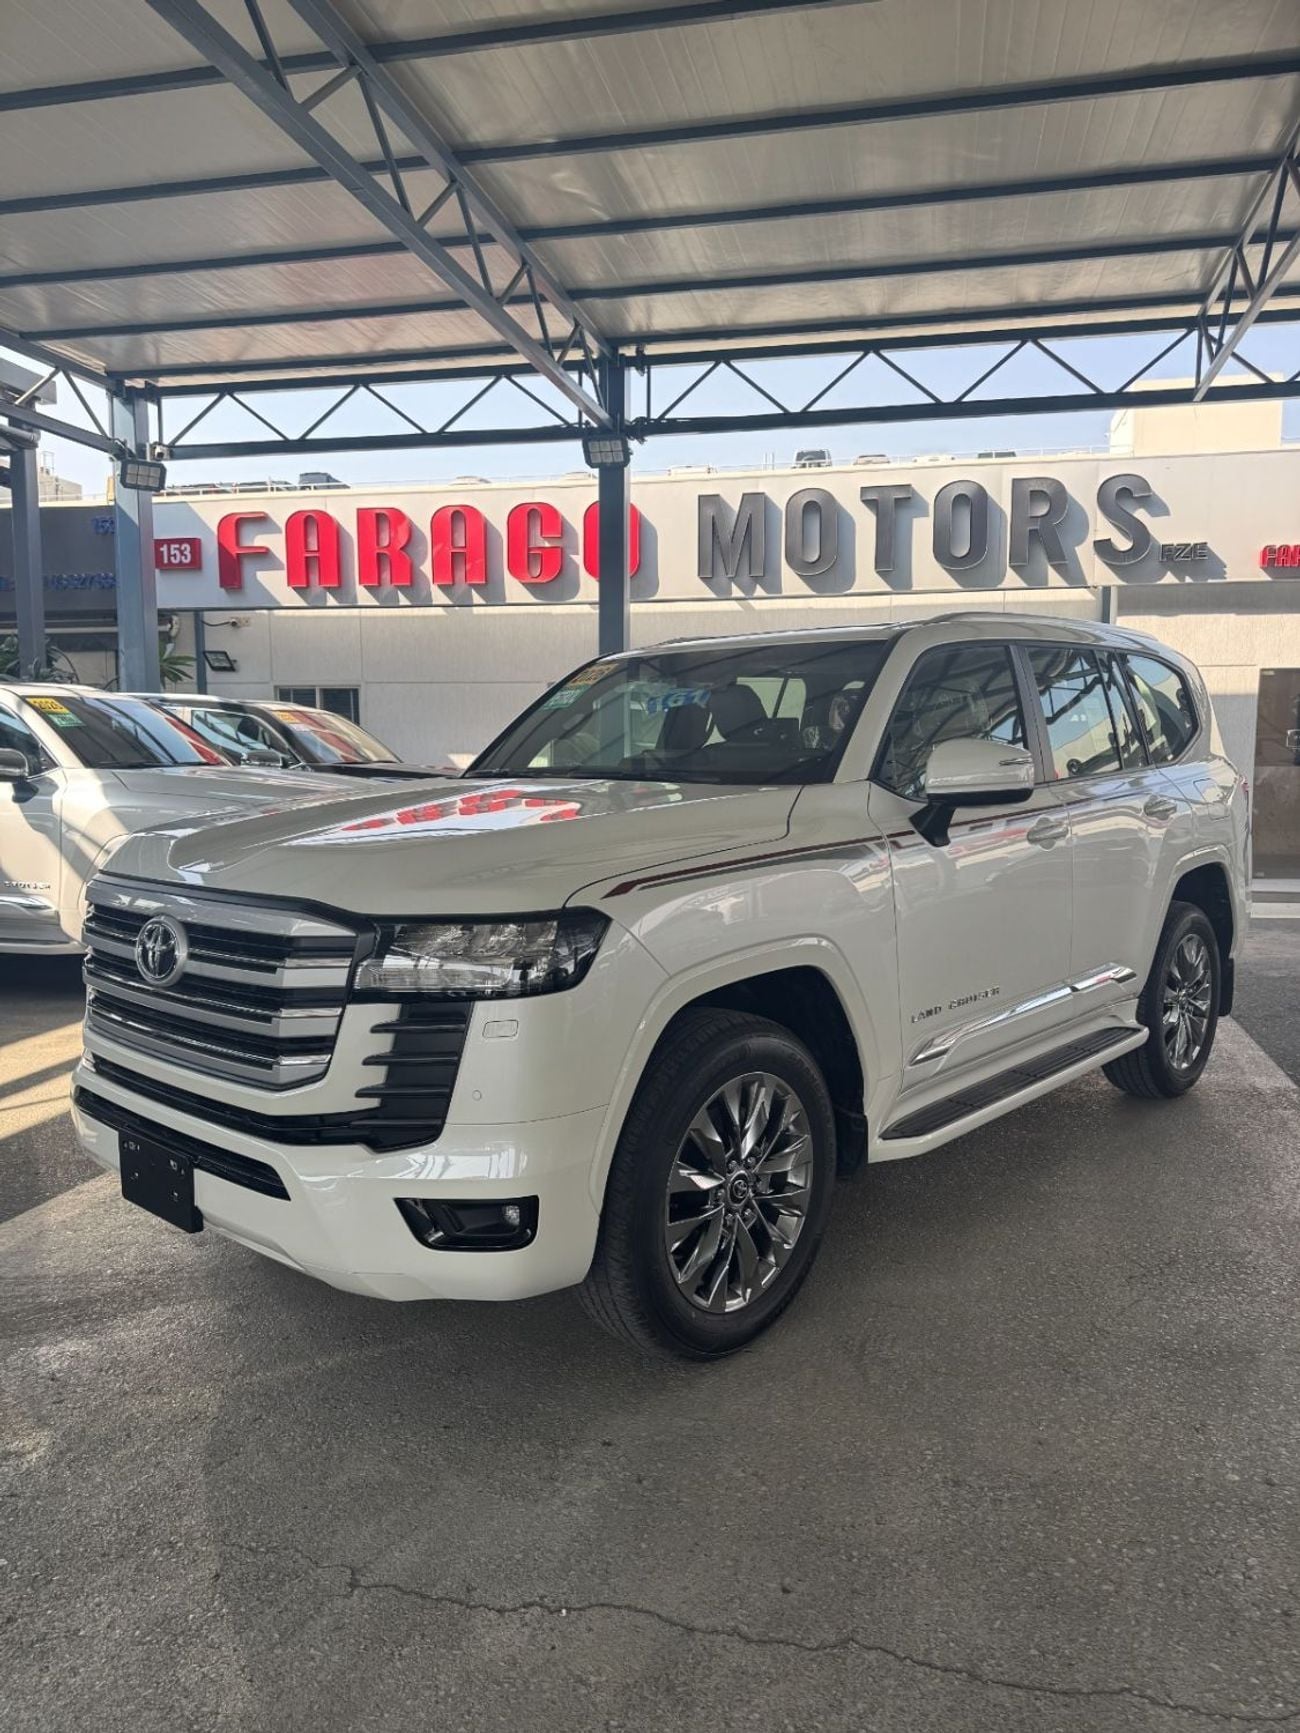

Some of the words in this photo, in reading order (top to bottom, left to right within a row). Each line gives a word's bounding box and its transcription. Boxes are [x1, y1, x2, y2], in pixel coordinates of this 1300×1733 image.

[697, 473, 1153, 578] MOTORS
[1159, 542, 1209, 562] FZE
[160, 543, 192, 565] 153
[911, 1005, 941, 1023] LAND
[948, 986, 1000, 1009] CRUISER
